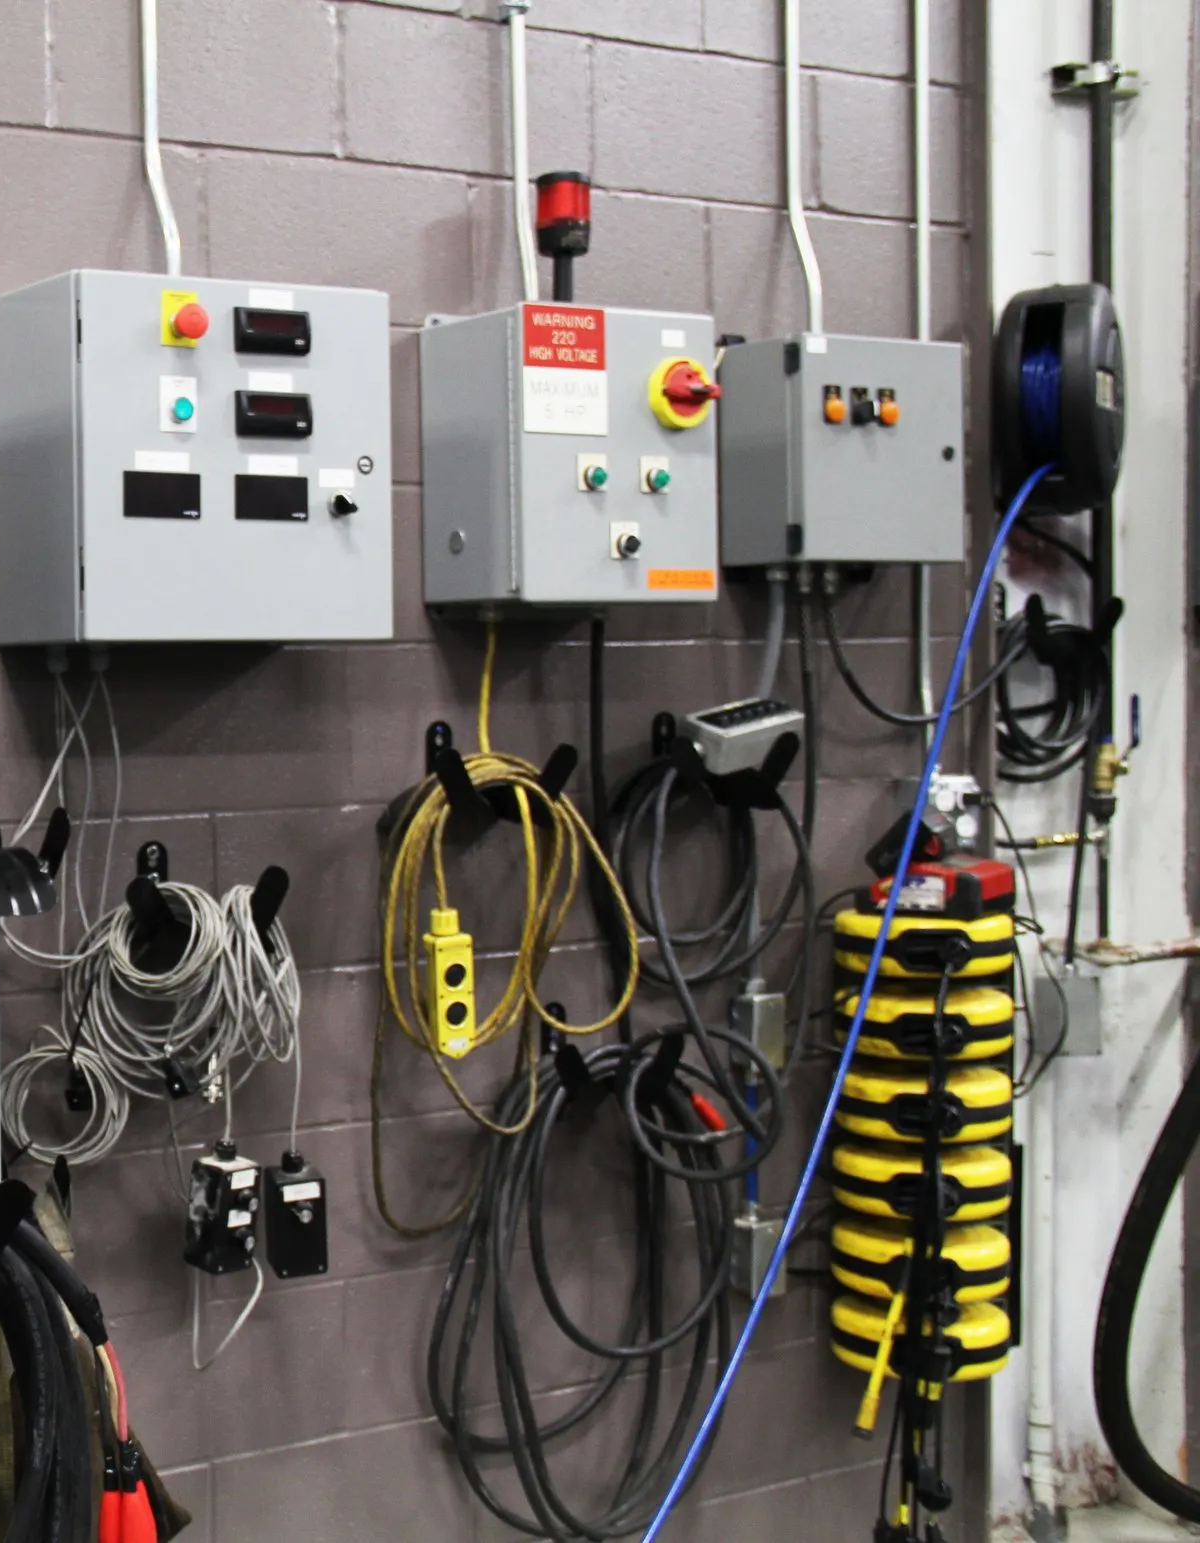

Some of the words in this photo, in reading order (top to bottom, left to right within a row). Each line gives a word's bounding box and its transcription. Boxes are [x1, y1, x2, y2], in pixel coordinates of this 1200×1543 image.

[531, 312, 596, 331] WARNING
[551, 330, 576, 346] 220
[528, 345, 553, 361] HIGH
[556, 347, 598, 364] VOLTAGE
